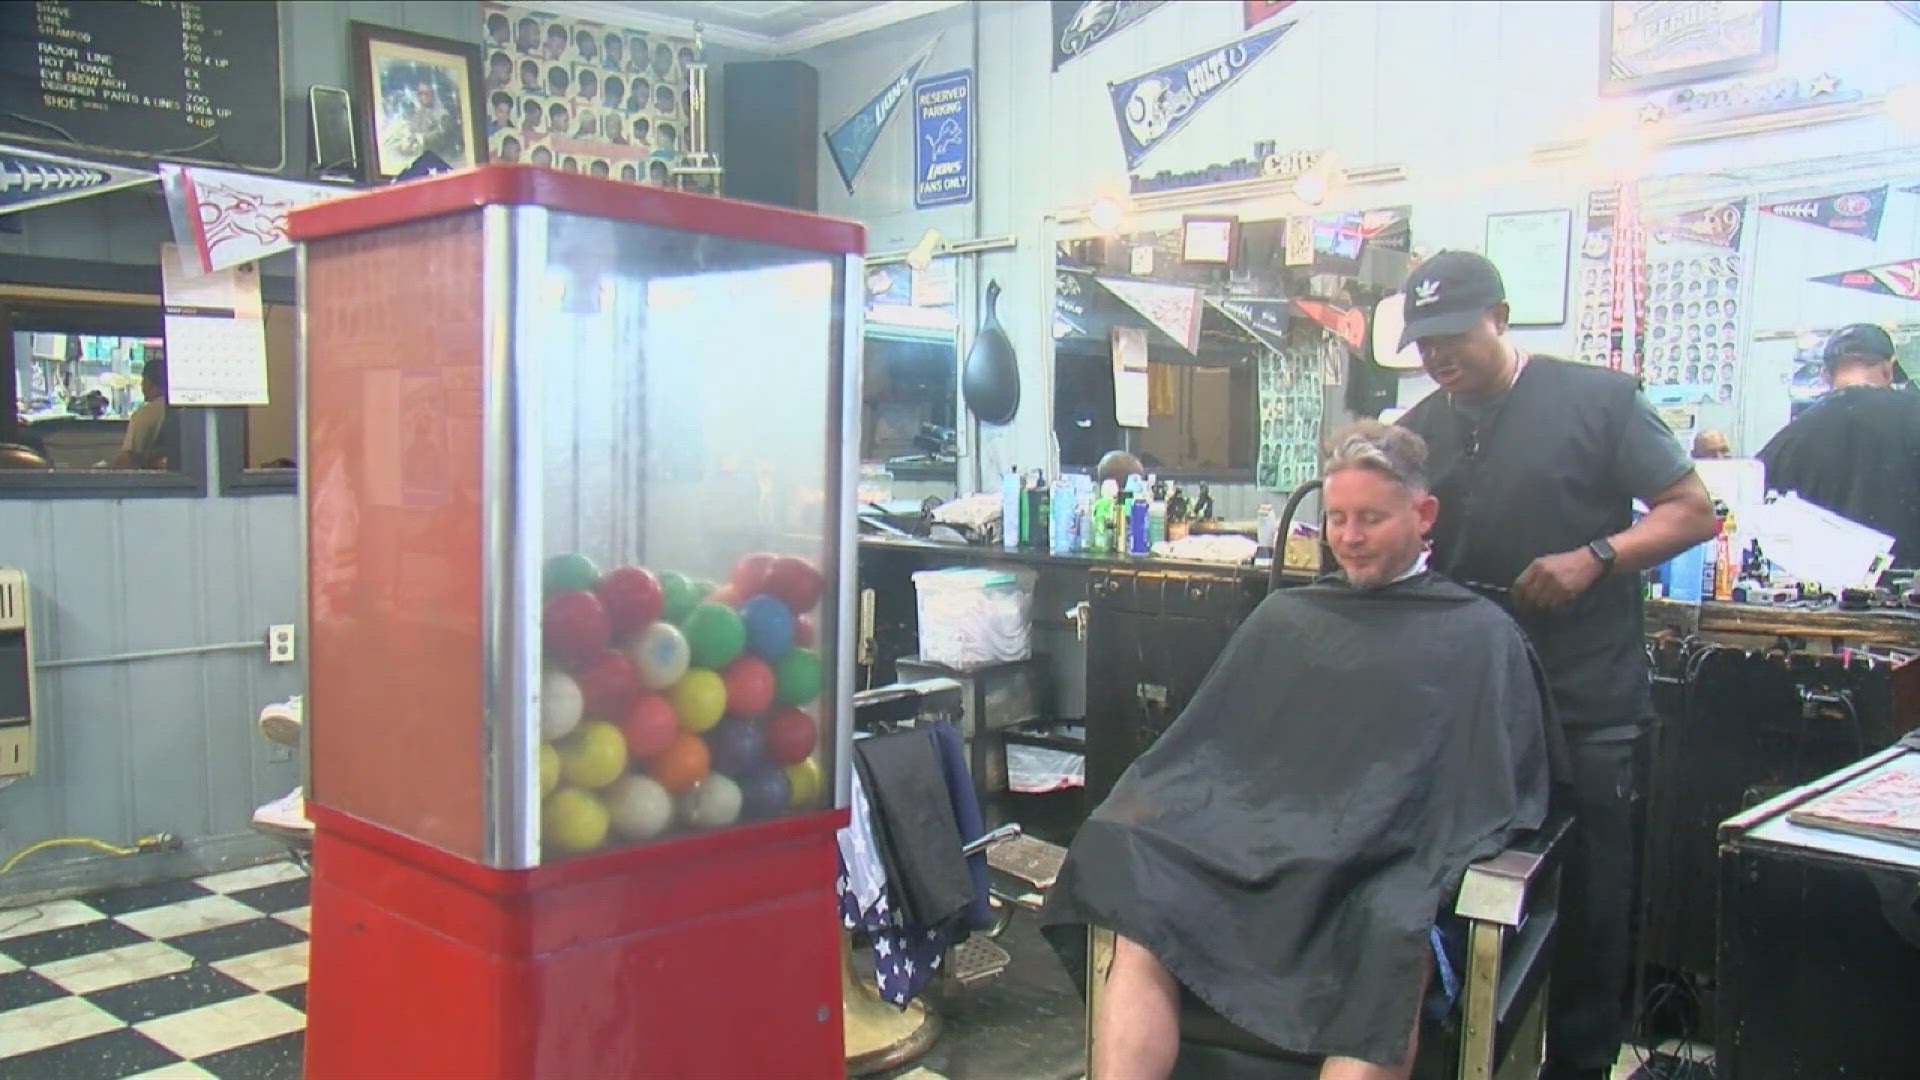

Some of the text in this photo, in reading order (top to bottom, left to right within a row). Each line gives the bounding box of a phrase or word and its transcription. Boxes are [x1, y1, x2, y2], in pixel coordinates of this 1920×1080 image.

[38, 42, 113, 67] RAZOR LINE
[39, 55, 114, 78] HOT TOWEL
[1187, 50, 1229, 97] COLTS
[41, 68, 63, 80] EYE
[66, 71, 98, 86] BROW
[44, 95, 77, 111] SHOE
[876, 76, 908, 126] LIONS
[920, 87, 966, 104] RESERVED
[923, 101, 961, 119] PARKING
[927, 160, 963, 181] LIONS
[920, 175, 967, 194] FANS ONLY
